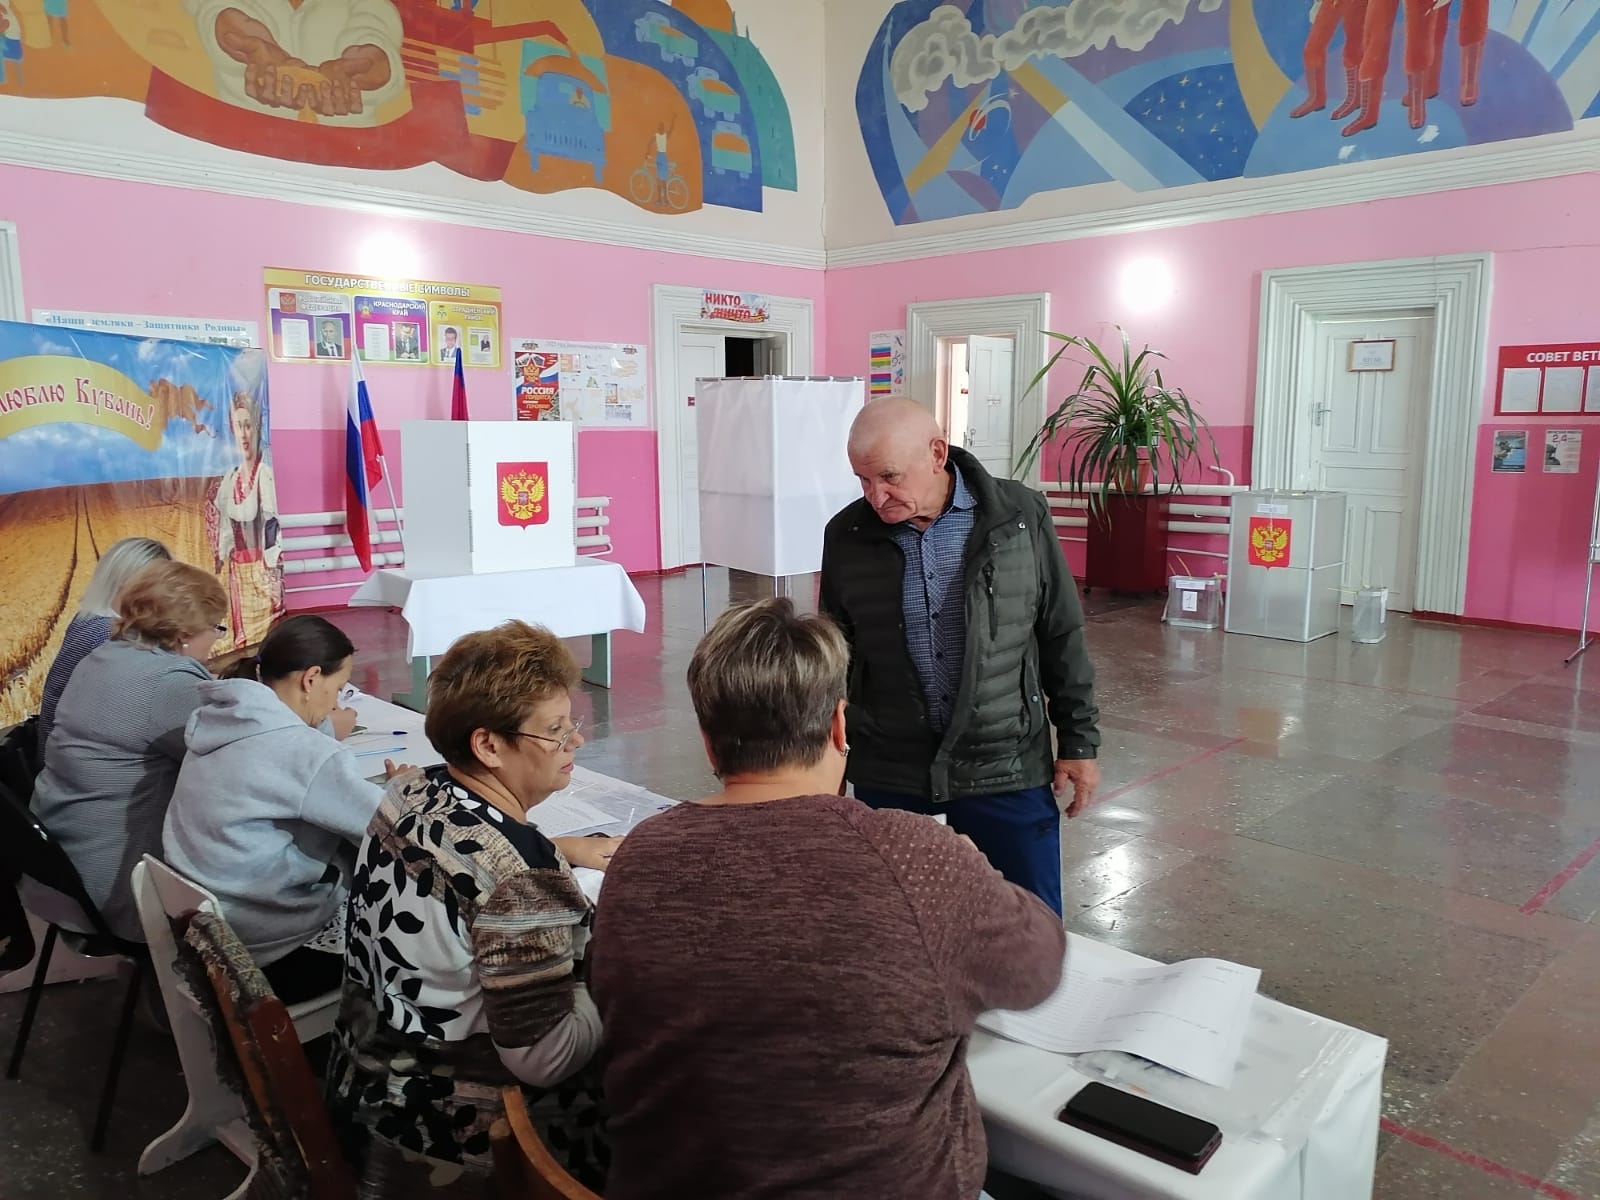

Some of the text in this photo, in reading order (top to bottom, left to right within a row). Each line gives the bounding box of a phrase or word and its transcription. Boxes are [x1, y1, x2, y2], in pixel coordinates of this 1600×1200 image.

[304, 274, 471, 297] ГОСУДАРСТВЕЫЕ СИМВОЛЫ
[705, 293, 741, 306] НИКТО
[373, 301, 426, 312] КРАСНОДАРСКИЙ
[392, 308, 409, 317] КРАЙ
[46, 315, 84, 326] «Наши
[91, 319, 134, 329] земляки
[143, 320, 200, 332] Защитники
[1526, 352, 1571, 363] СОВЕТ
[521, 386, 554, 395] РОССИЯ
